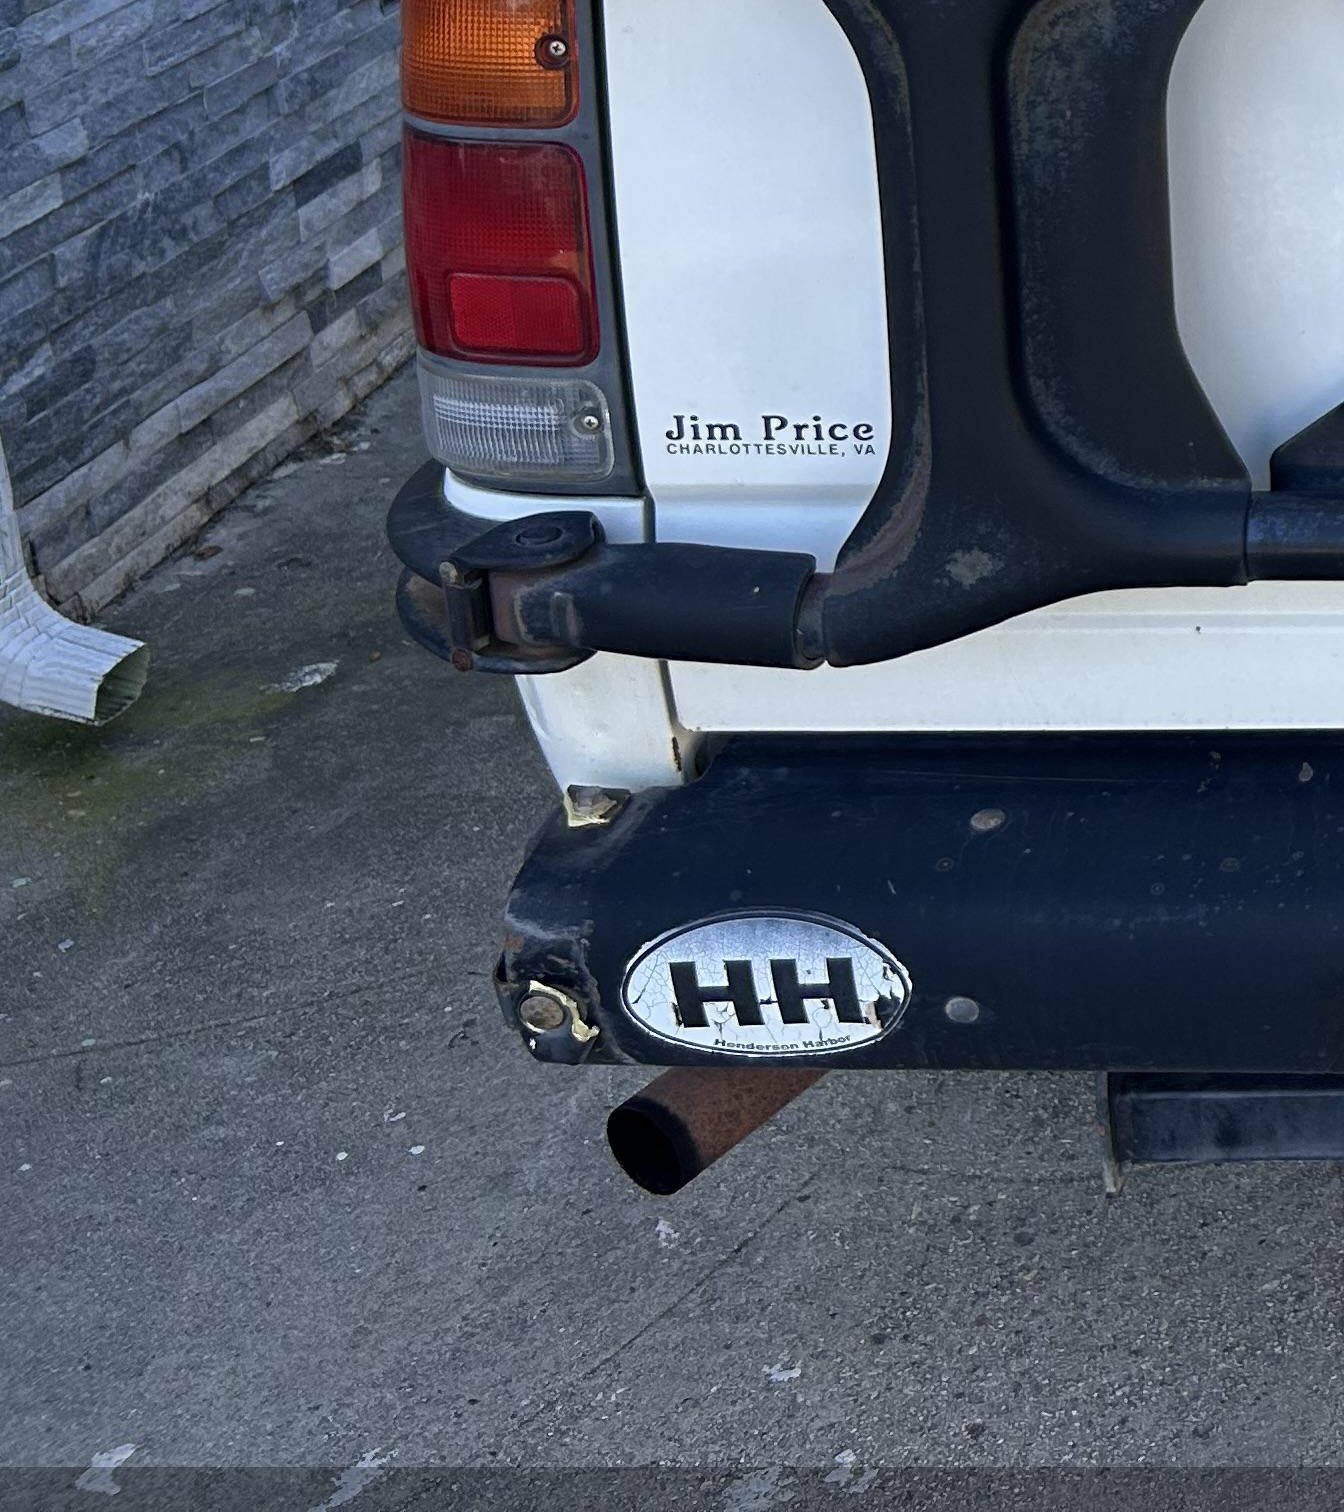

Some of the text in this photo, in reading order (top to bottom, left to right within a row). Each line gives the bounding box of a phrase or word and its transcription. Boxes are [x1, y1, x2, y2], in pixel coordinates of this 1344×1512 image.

[665, 414, 874, 441] Jim Price
[666, 442, 876, 457] CHARLOTTESVILLE, VA
[668, 957, 866, 1028] HH
[714, 1034, 852, 1051] Henderson Harbor
